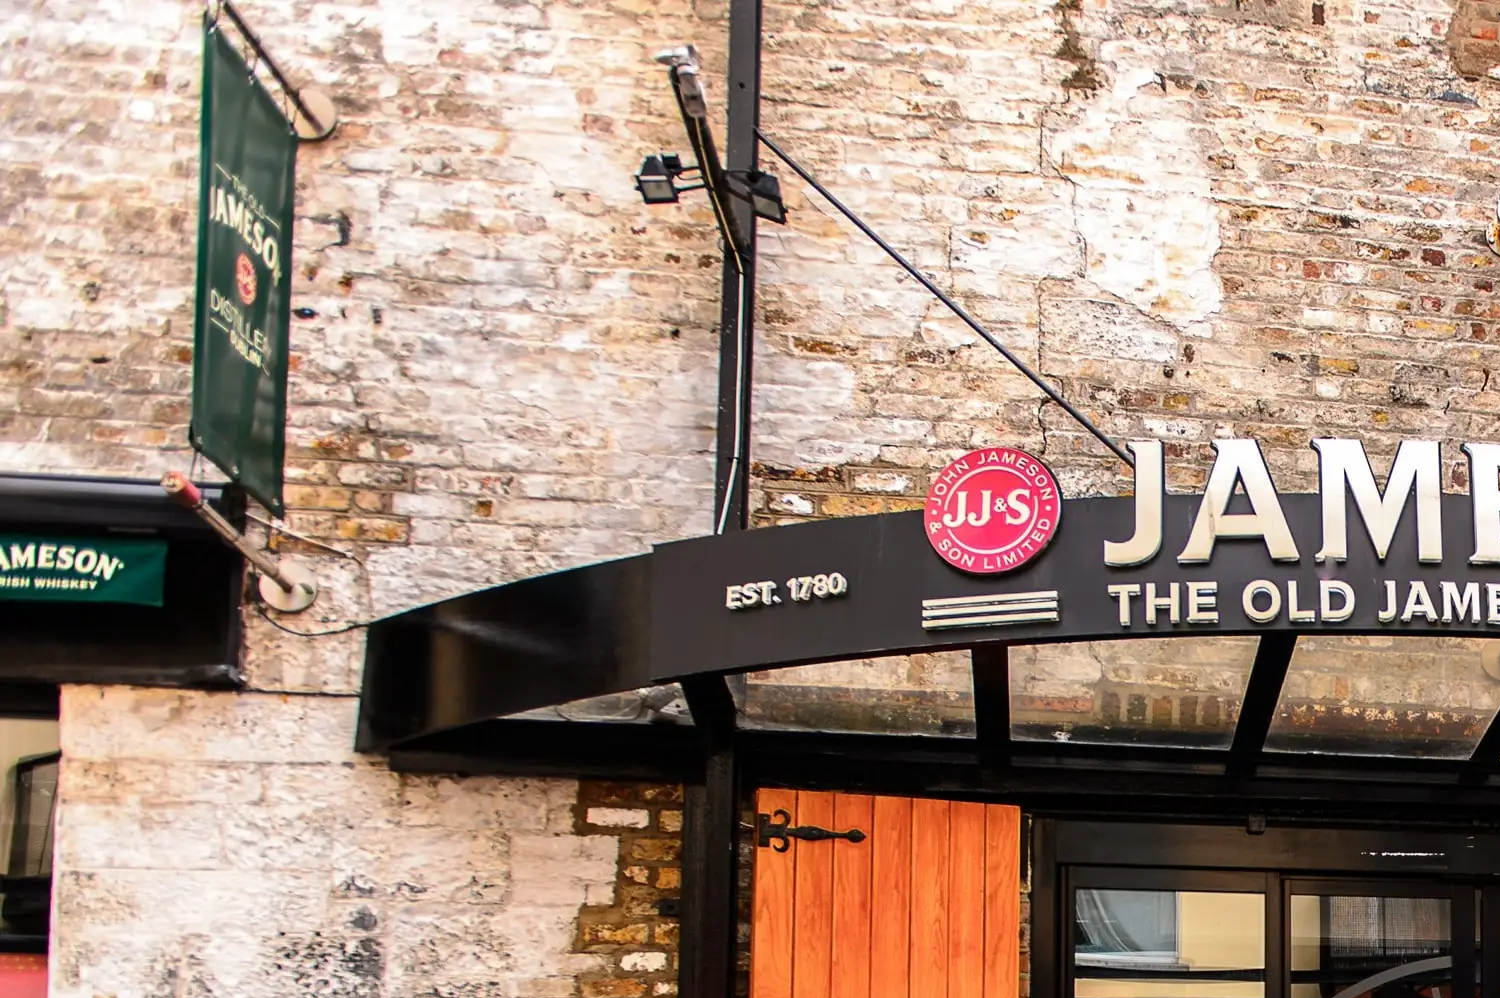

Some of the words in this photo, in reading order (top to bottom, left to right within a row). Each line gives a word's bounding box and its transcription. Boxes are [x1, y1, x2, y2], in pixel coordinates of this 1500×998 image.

[930, 459, 969, 506] JOHN
[977, 451, 1054, 501] JAMESON
[943, 489, 1031, 527] JJ&S
[0, 543, 118, 581] AMESON
[938, 539, 975, 568] SON
[984, 518, 1050, 569] LIMITED
[0, 575, 30, 588] RISH
[34, 576, 98, 590] WHISKEY
[725, 581, 781, 609] EST.
[787, 572, 847, 602] 1780
[1108, 580, 1220, 627] THE
[1242, 578, 1357, 623] OLD
